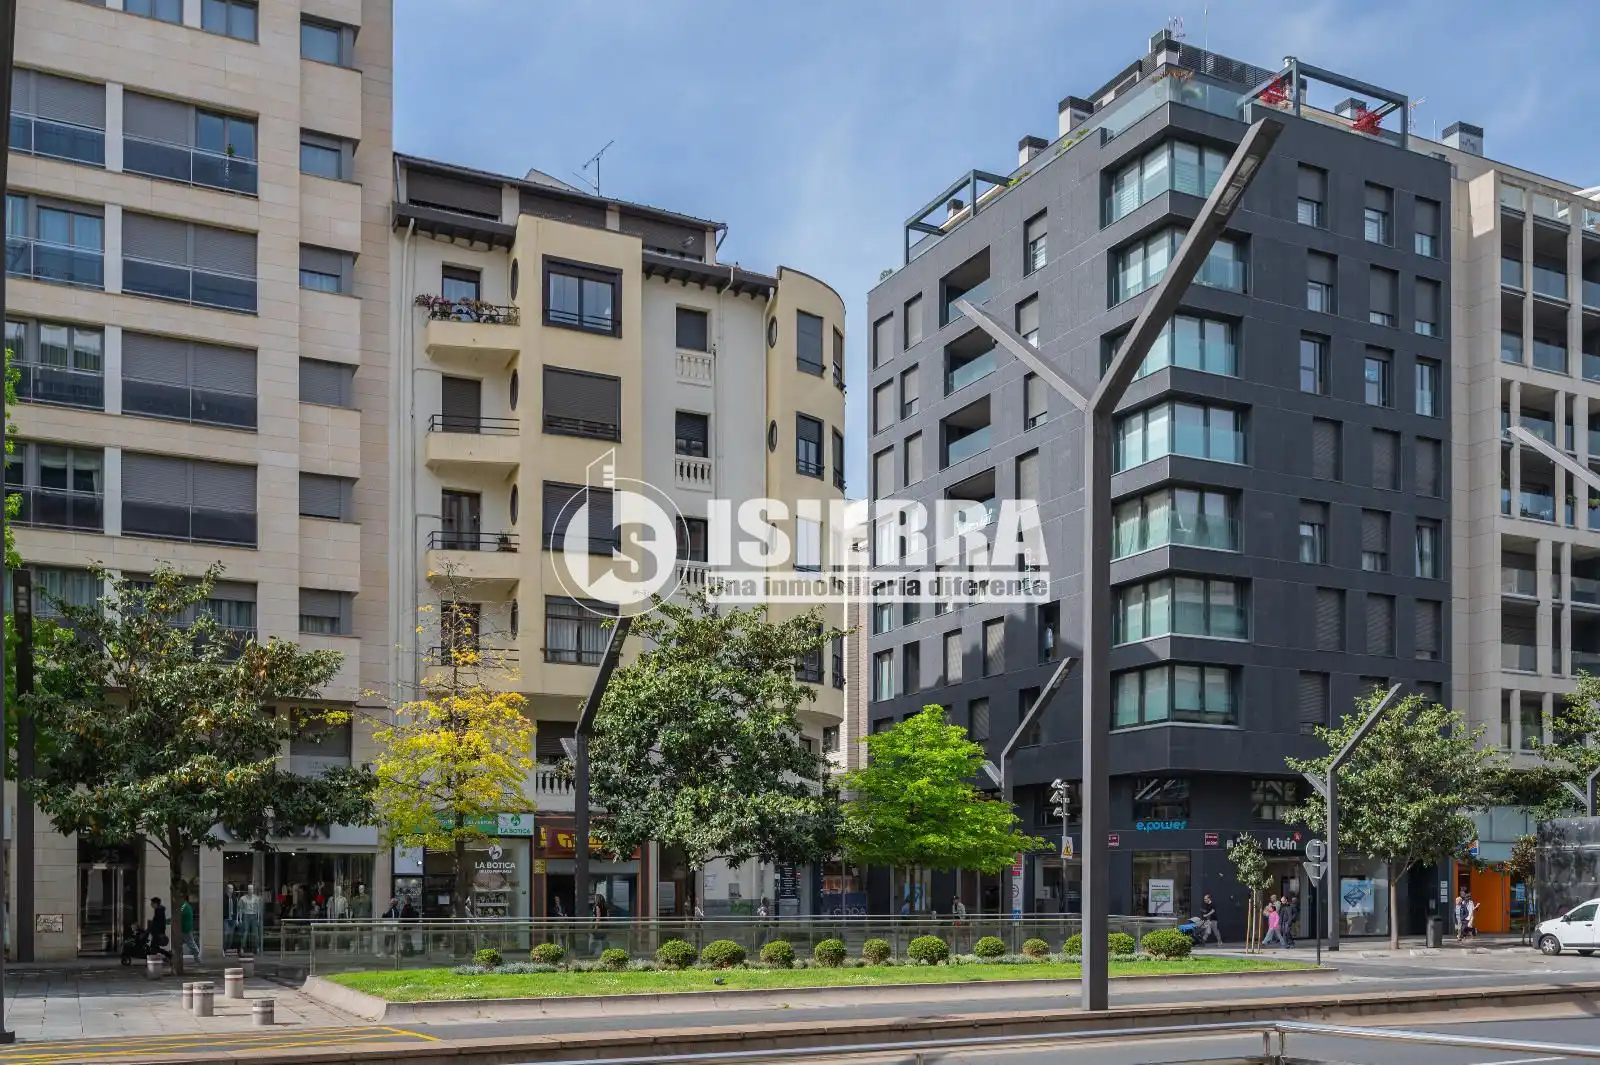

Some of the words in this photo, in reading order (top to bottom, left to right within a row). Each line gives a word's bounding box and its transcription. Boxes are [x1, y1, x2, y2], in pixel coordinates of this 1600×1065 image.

[1267, 837, 1297, 850] k-tuin
[475, 861, 486, 869] LA
[486, 861, 516, 869] BOTICA
